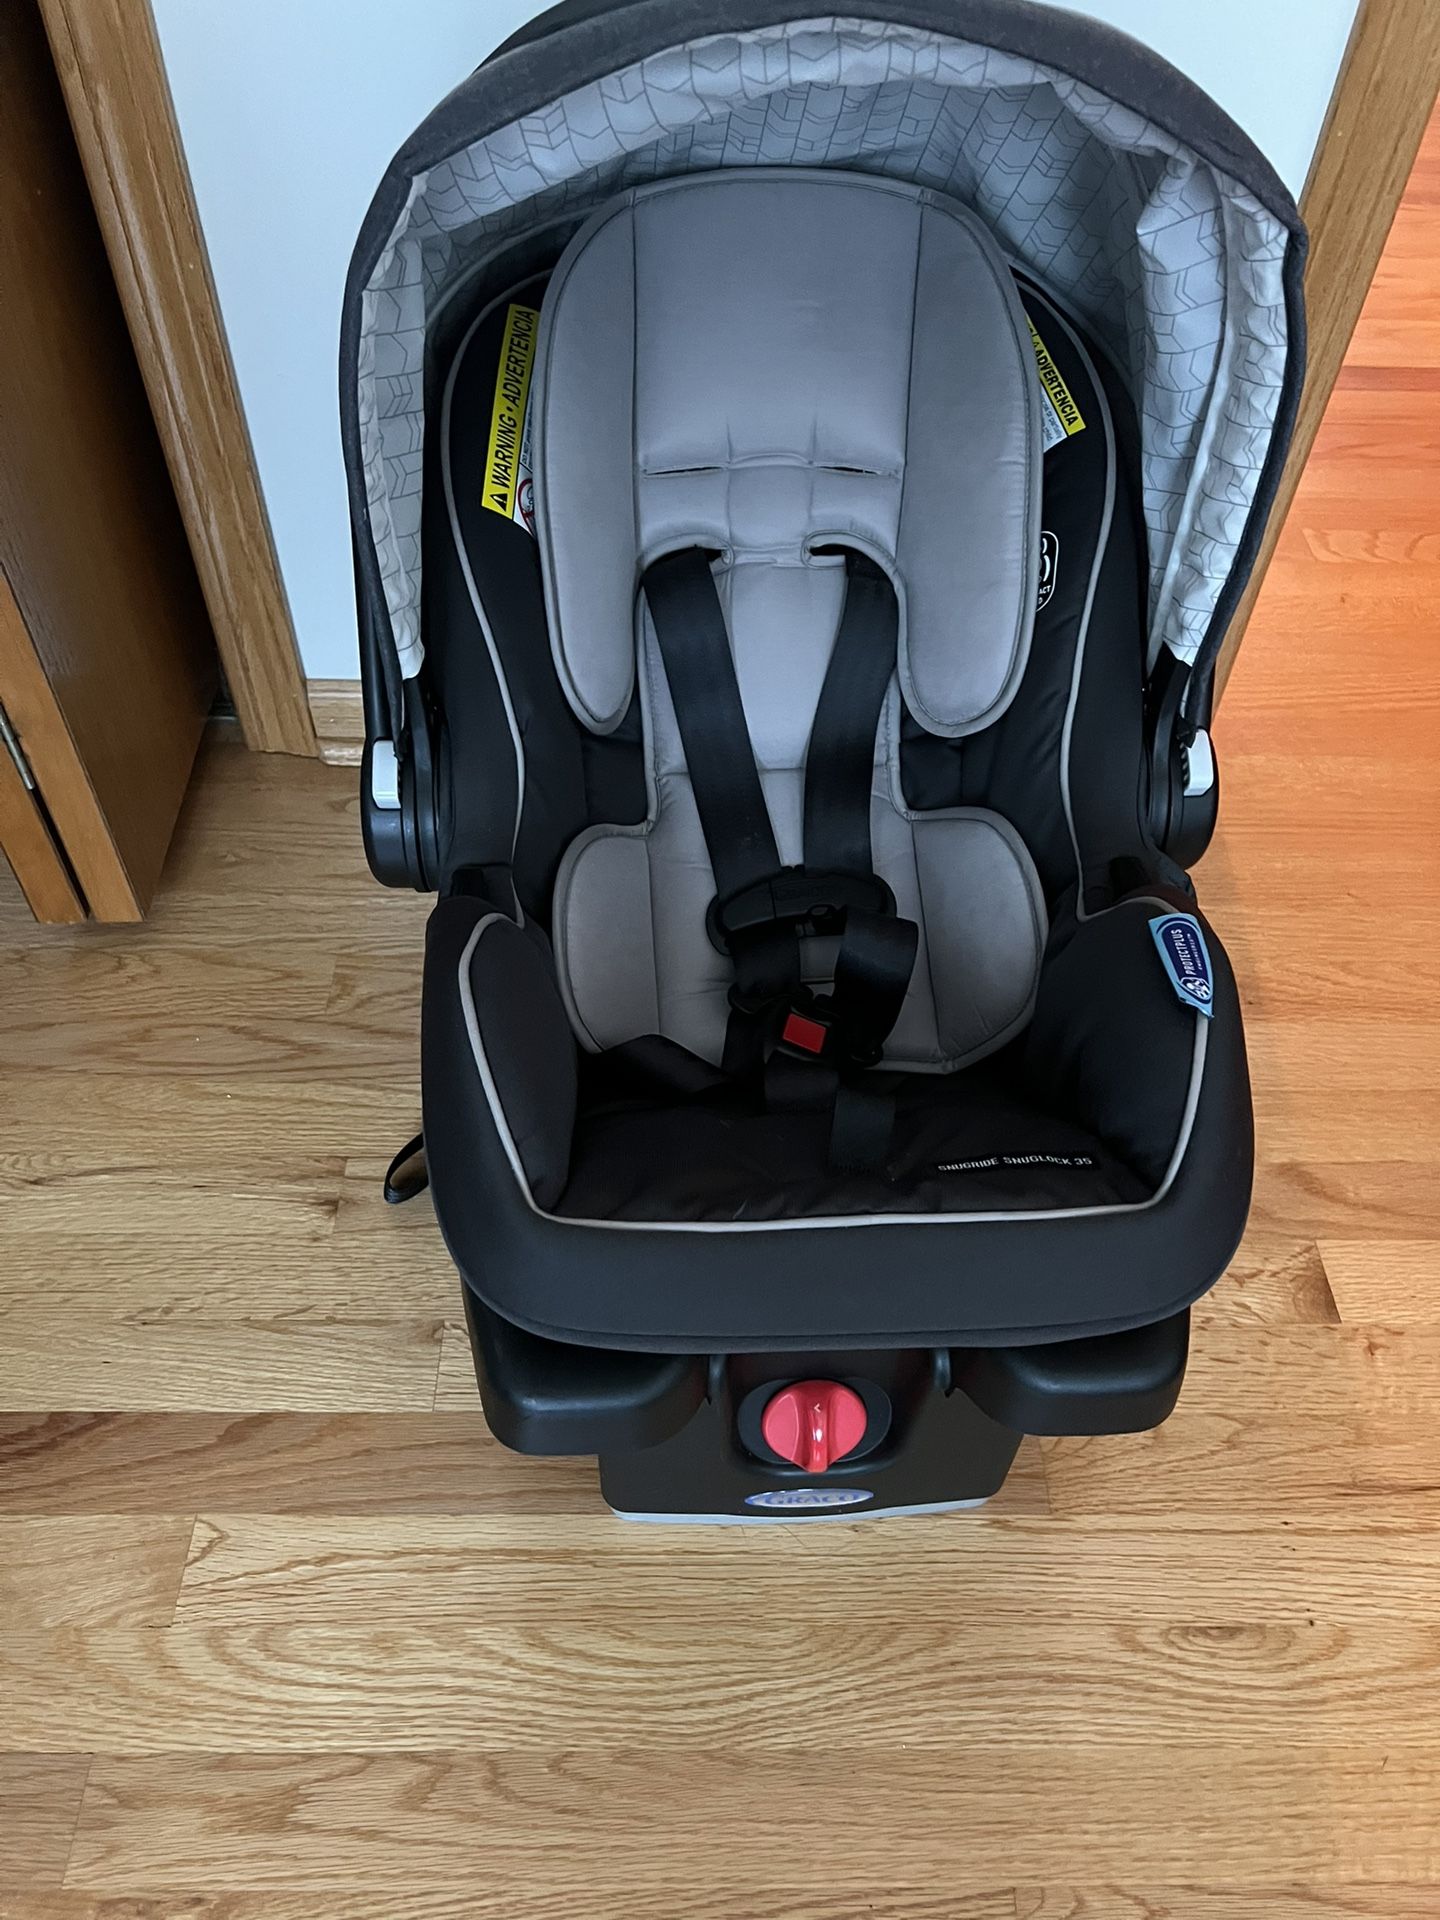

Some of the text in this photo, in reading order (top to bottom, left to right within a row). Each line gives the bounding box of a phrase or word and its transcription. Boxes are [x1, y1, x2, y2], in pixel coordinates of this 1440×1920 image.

[491, 310, 535, 489] WARNING ADVERTENCIA
[1171, 928, 1197, 976] PROTECTPLUS
[938, 1155, 1093, 1171] SNUGRIDE SNUGLOCK 35
[765, 1492, 860, 1505] GRACO
